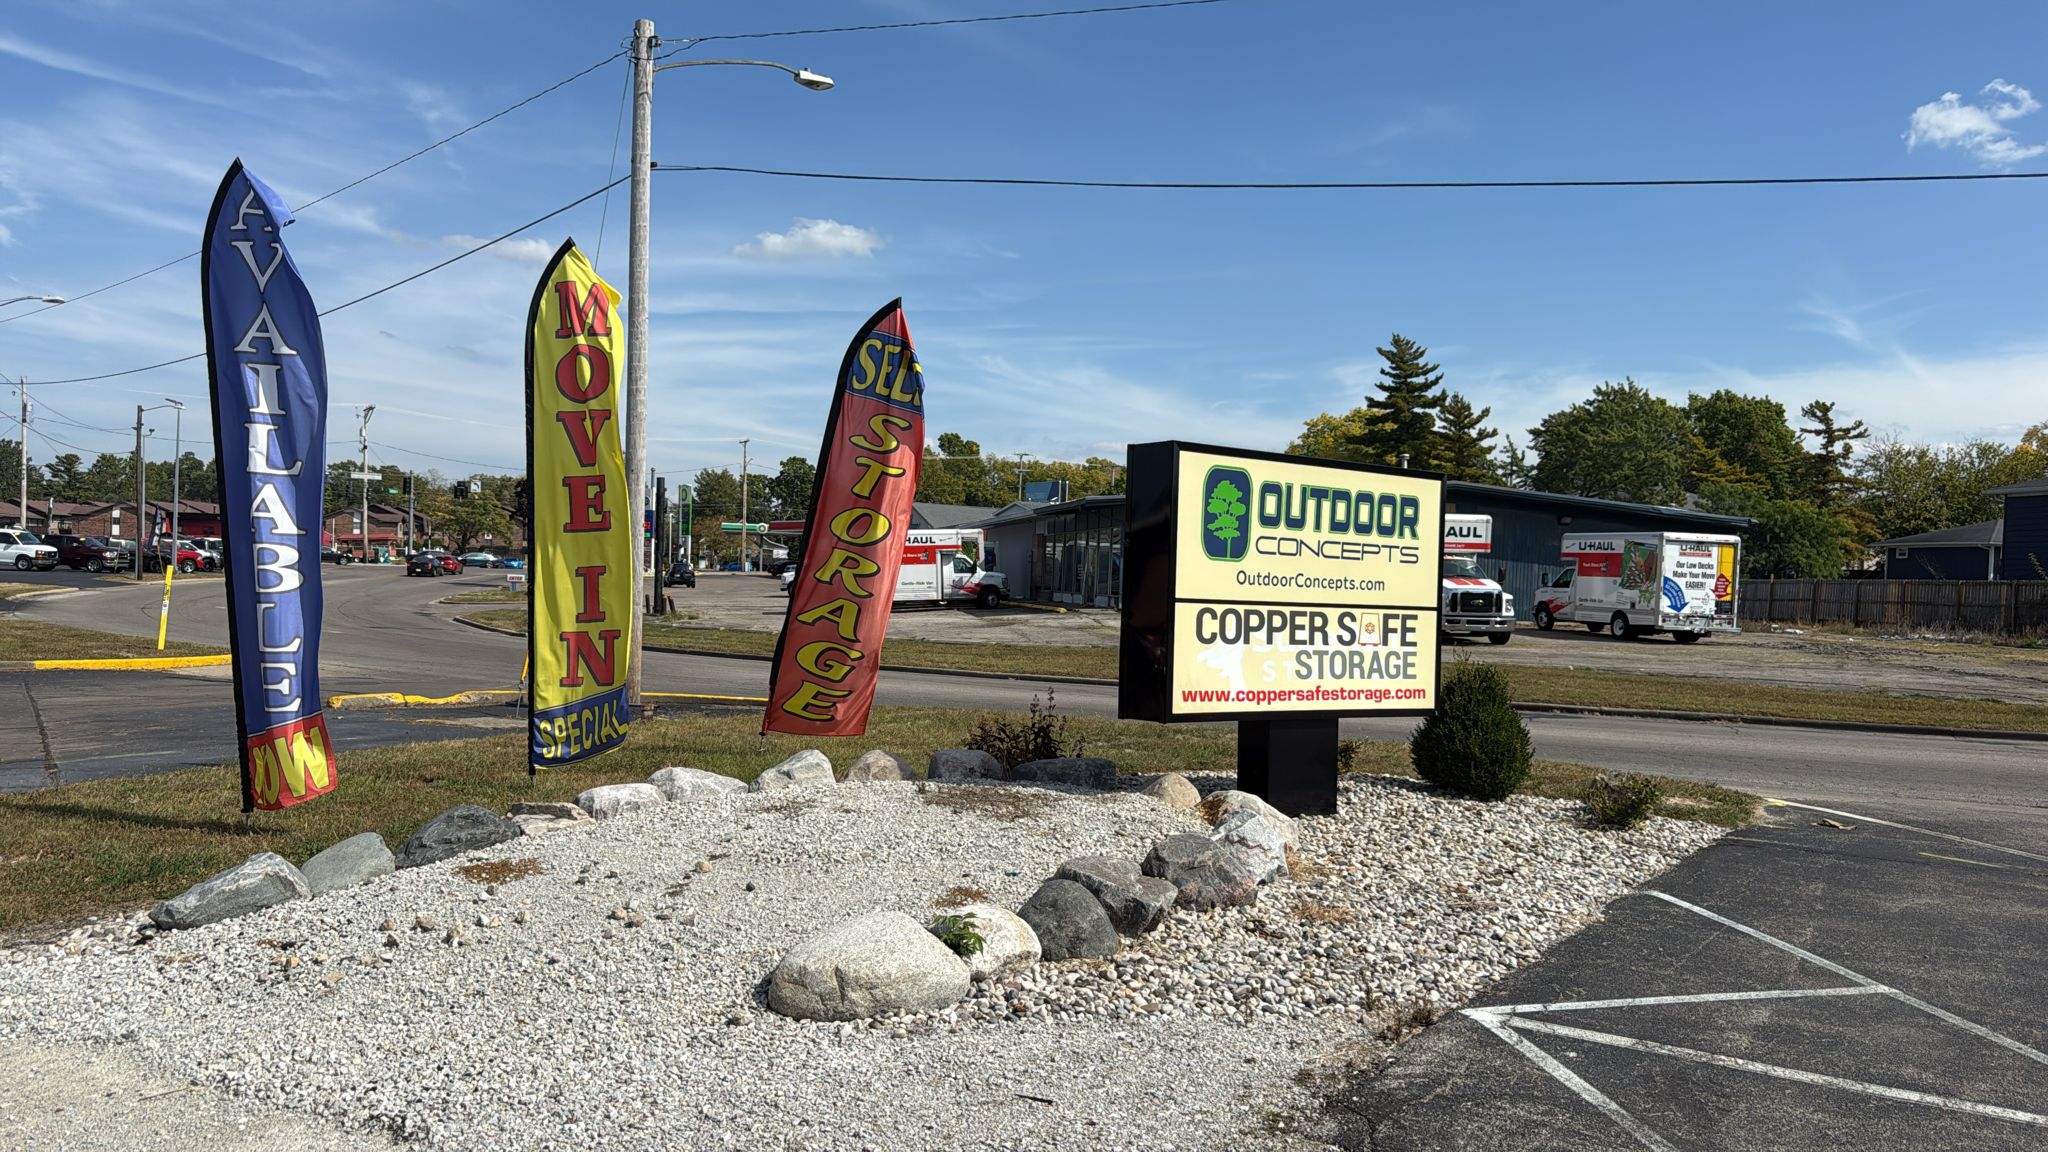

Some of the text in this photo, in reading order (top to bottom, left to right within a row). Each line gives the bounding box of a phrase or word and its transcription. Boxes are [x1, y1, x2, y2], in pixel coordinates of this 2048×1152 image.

[230, 180, 307, 713] AVAILABLE
[555, 280, 621, 687] MOVE IN
[1258, 480, 1420, 540] OUTDOOR
[1446, 526, 1482, 538] AUL
[1255, 536, 1419, 564] CONCEPTS
[781, 413, 912, 722] STORAGE
[1672, 570, 1687, 578] Make
[1689, 571, 1700, 579] Your
[1676, 560, 1714, 570] Our Low Decks
[1236, 570, 1385, 591] OutdoorConcepts.com
[1685, 581, 1706, 589] EASIER!
[1195, 607, 1418, 647] COPPER SFE
[1295, 650, 1417, 680] STORAGE
[1182, 685, 1427, 706] www.coppersafestorage.com
[539, 699, 629, 759] SPECIAL
